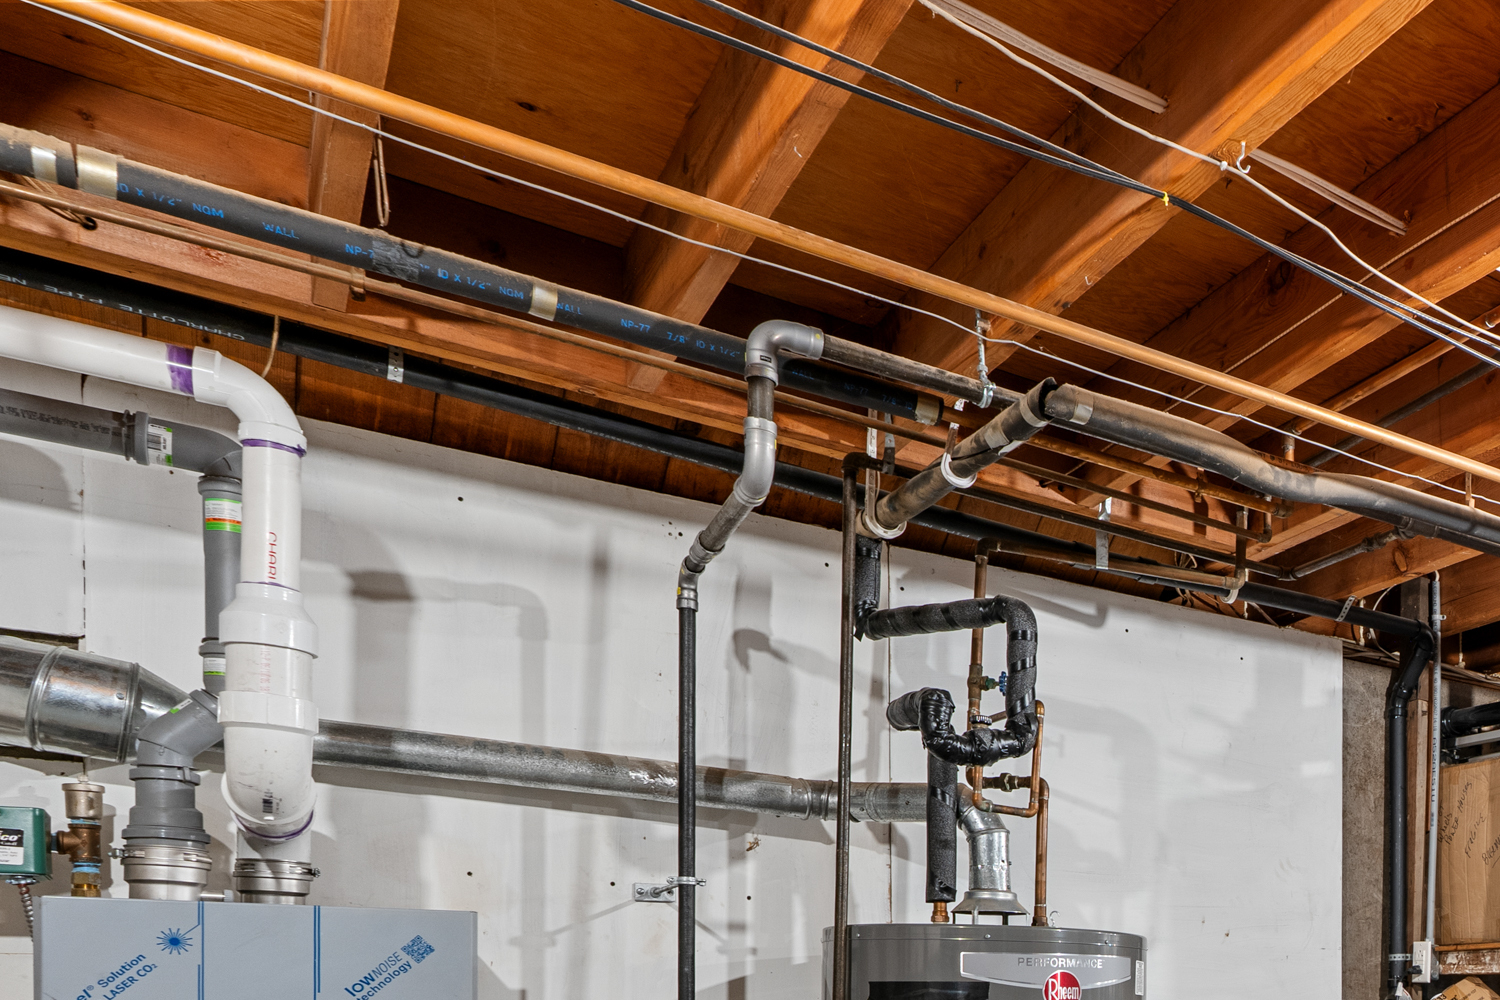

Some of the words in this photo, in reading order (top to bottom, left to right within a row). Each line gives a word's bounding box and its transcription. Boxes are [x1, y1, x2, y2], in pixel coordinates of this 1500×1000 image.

[262, 221, 300, 240] WALL
[620, 318, 651, 334] NP-77
[97, 953, 147, 988] Solution
[1017, 957, 1103, 969] PERFORMANCE
[103, 975, 139, 1000] LASER
